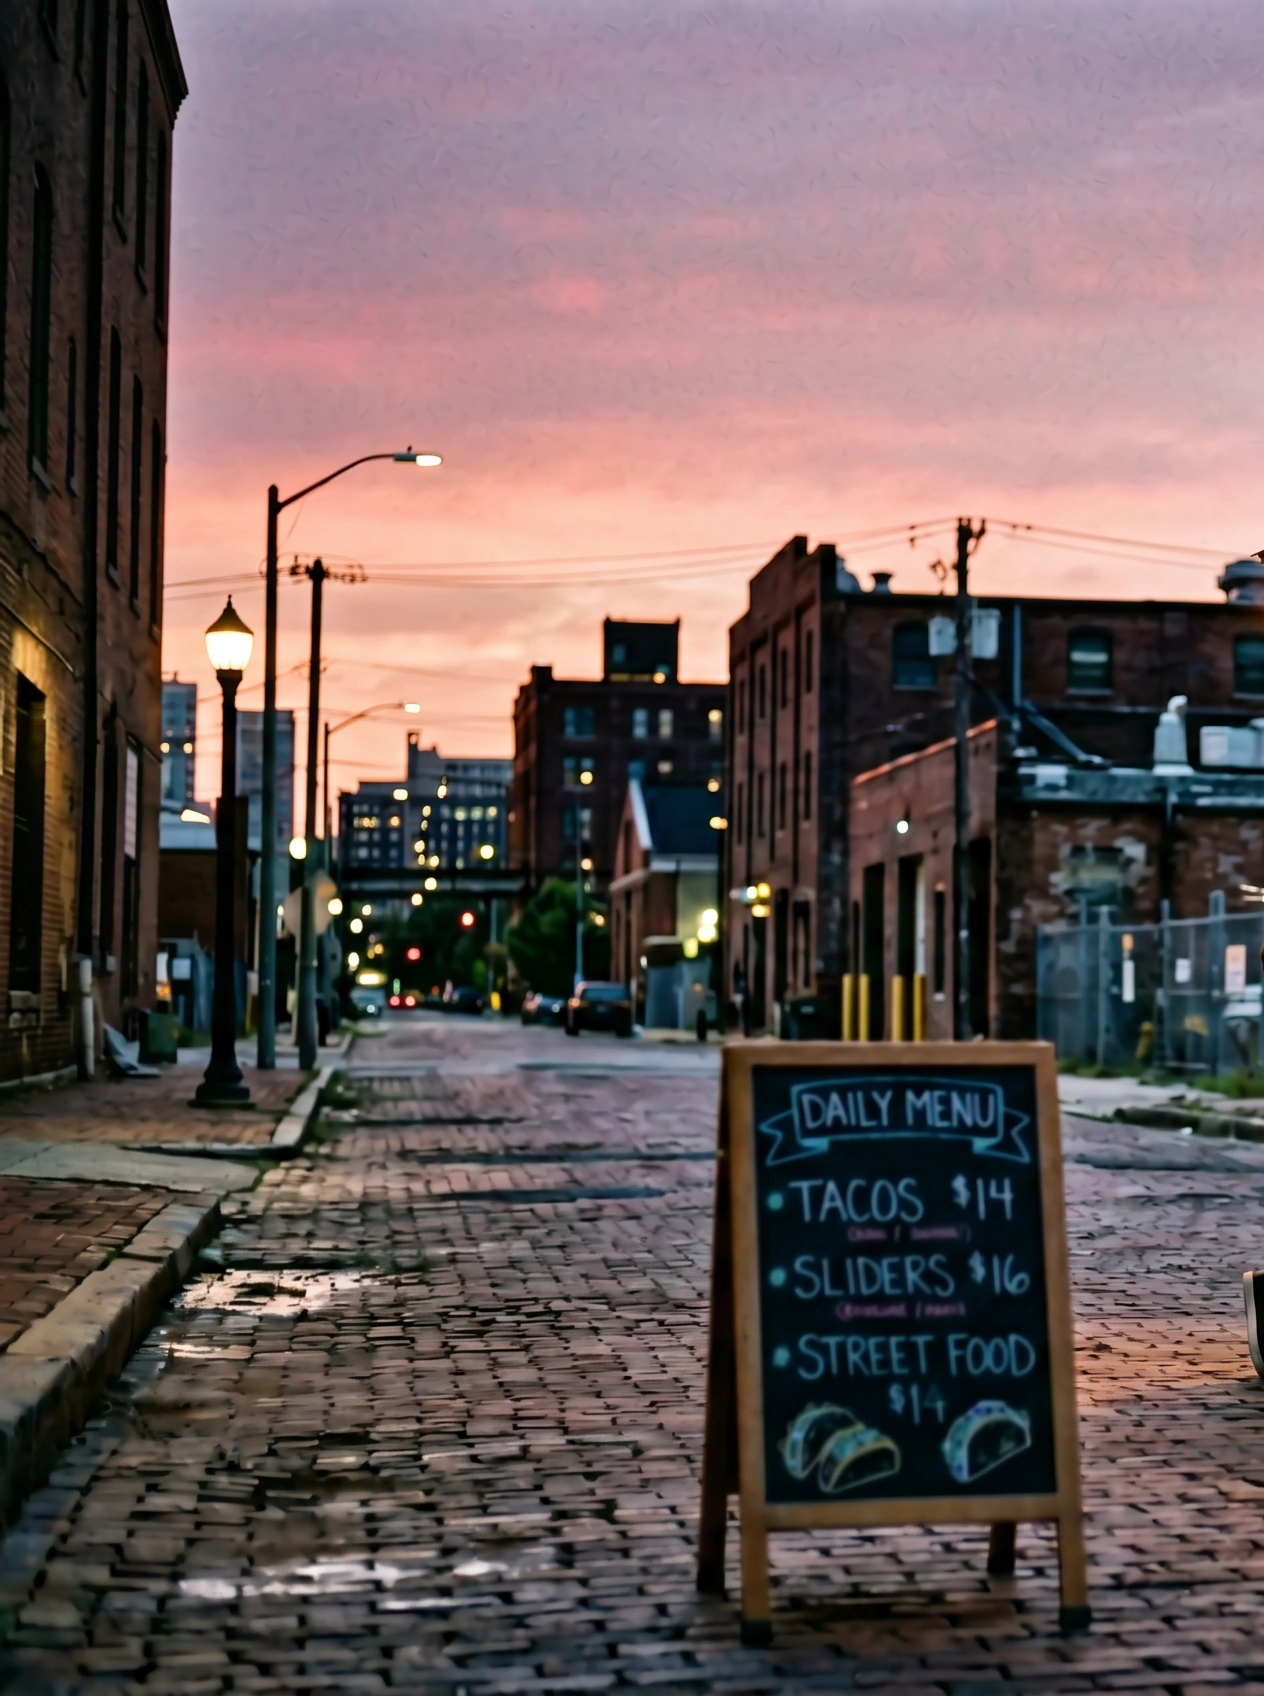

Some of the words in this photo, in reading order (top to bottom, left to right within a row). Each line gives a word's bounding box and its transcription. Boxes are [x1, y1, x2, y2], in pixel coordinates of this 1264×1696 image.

[800, 1089, 893, 1129] DAILY
[905, 1089, 996, 1127] MENU
[788, 1177, 924, 1222] TACOS
[952, 1173, 1013, 1220] $14
[794, 1253, 955, 1299] SLIDERS
[969, 1251, 1030, 1294] $16
[798, 1333, 934, 1380] STREET
[949, 1333, 1036, 1377] FOOD
[889, 1382, 944, 1425] $14
